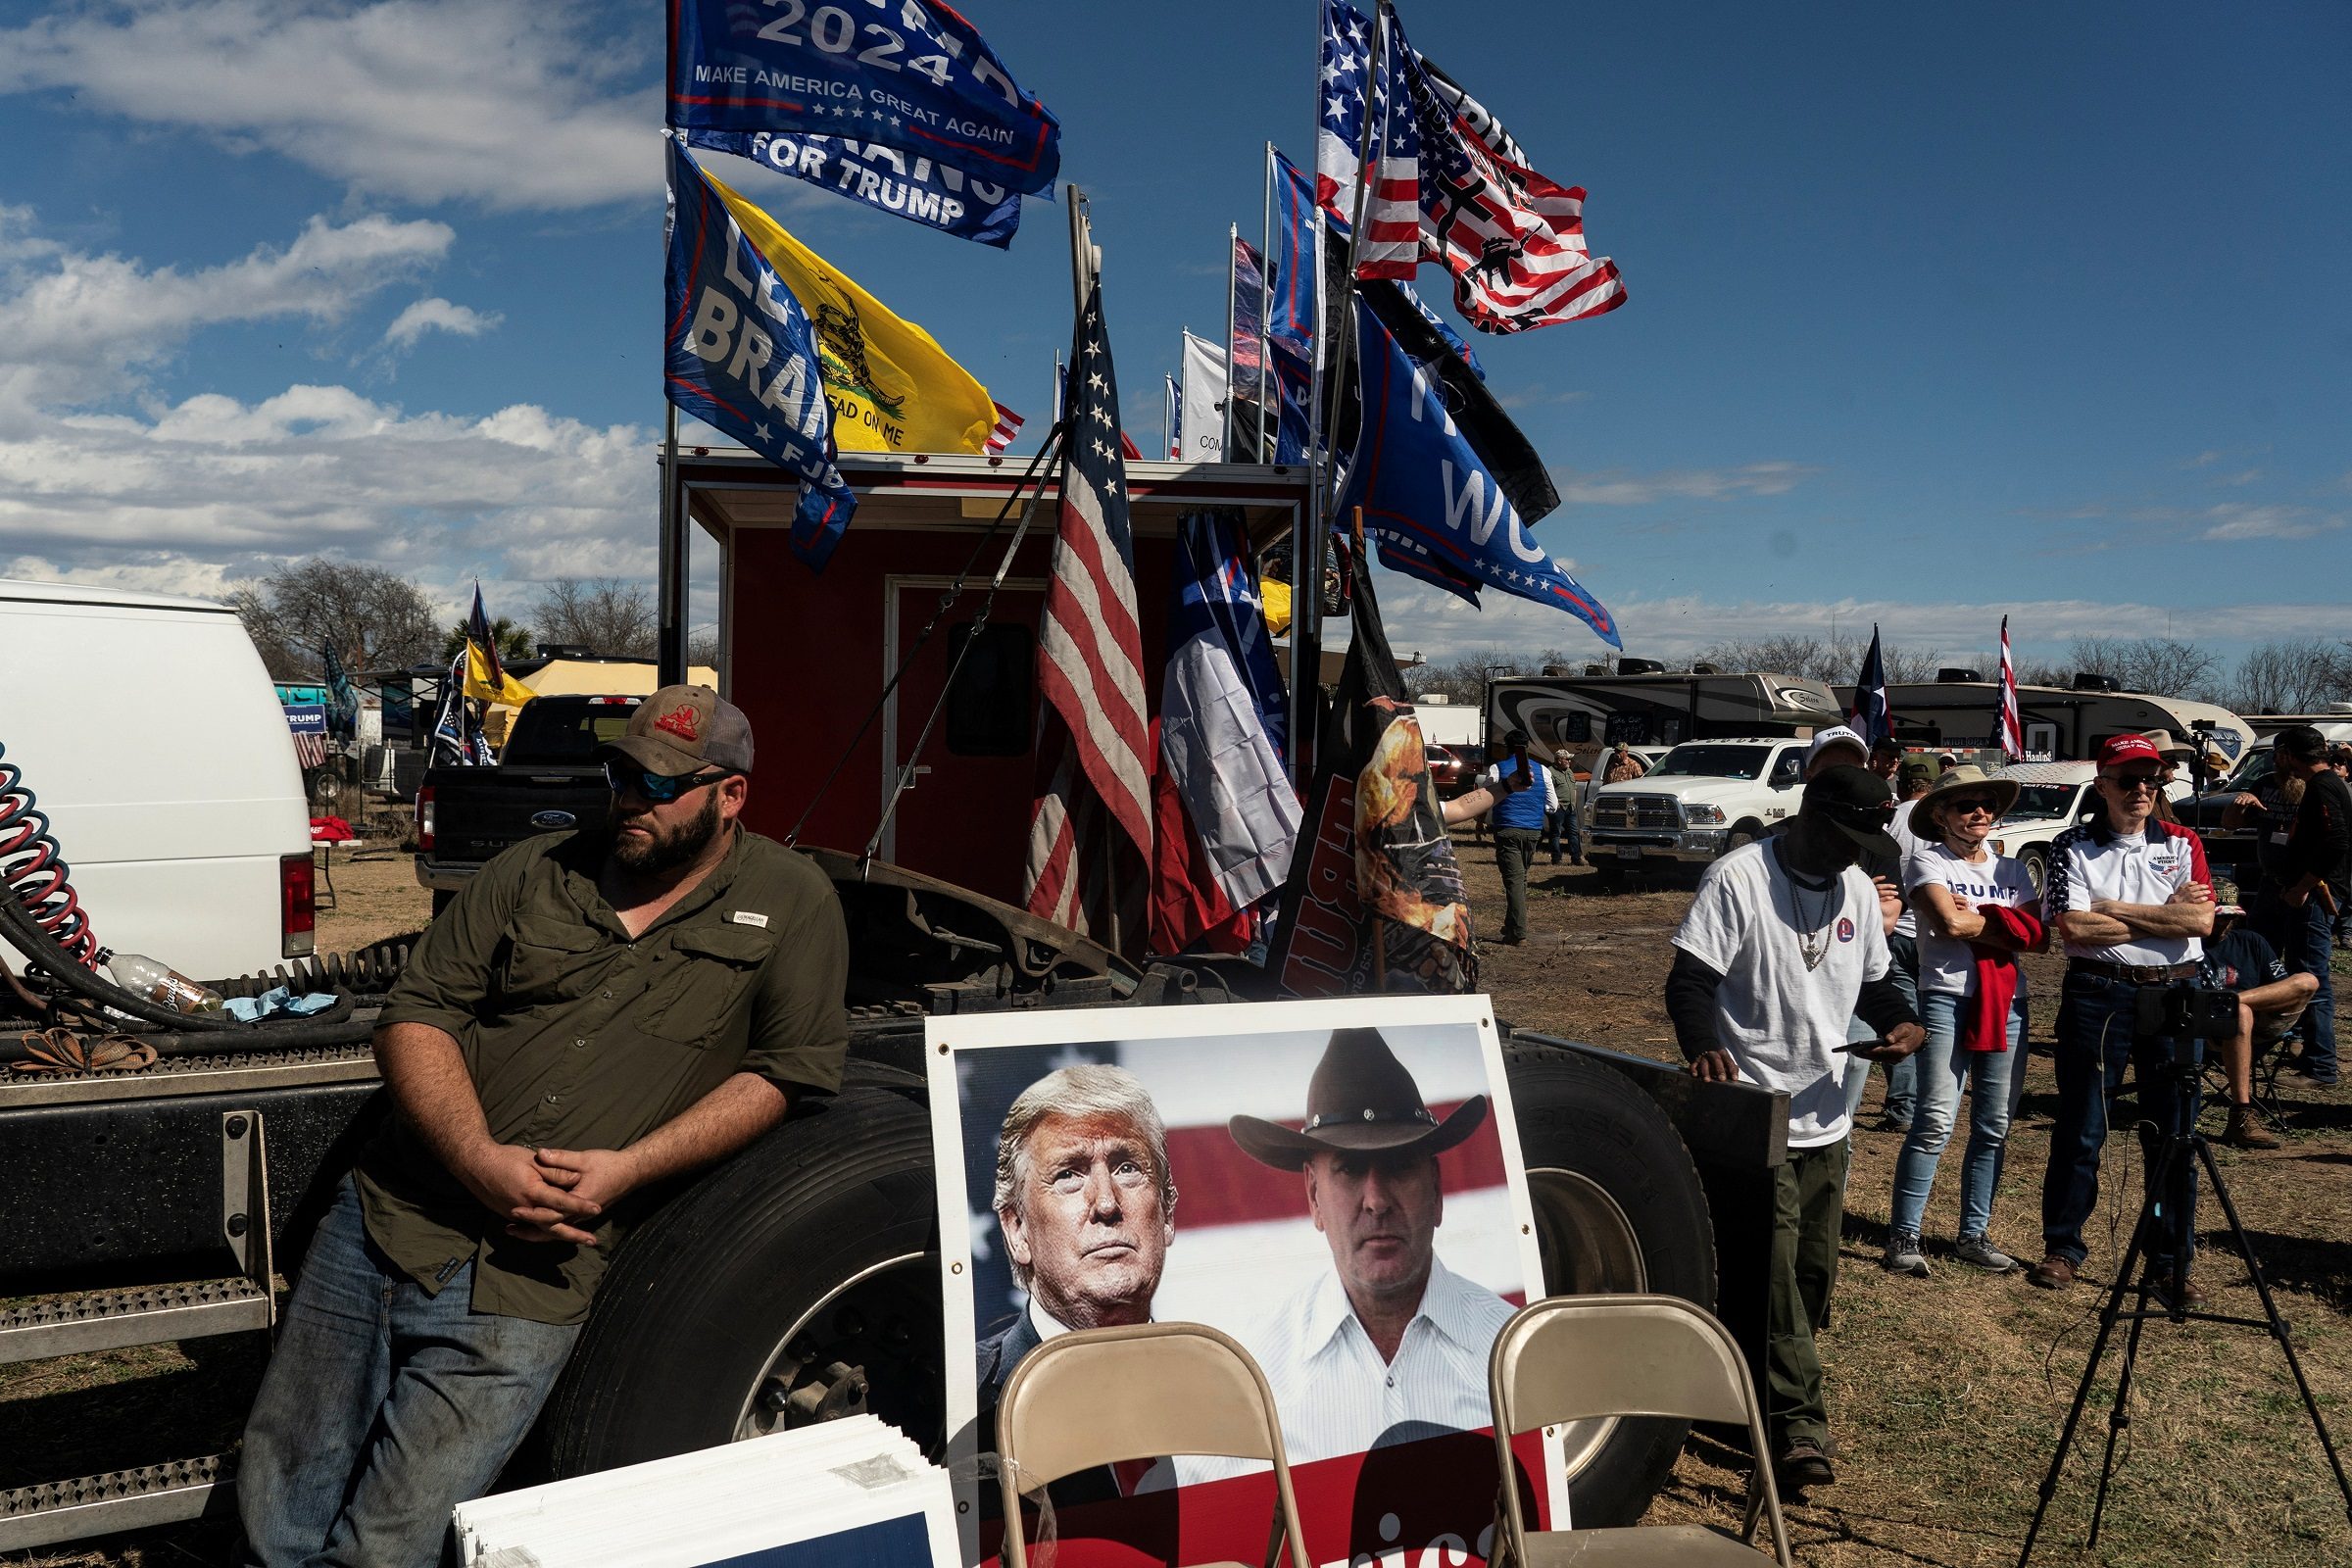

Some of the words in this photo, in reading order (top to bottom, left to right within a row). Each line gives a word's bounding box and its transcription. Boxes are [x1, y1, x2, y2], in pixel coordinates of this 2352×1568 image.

[757, 0, 954, 86] 2024
[696, 65, 747, 84] MAKE
[754, 70, 862, 100] AMERICA
[870, 89, 940, 126] GREAT
[946, 117, 1013, 145] AGAIN
[753, 132, 827, 178] FOR
[840, 157, 964, 225] TRUMP
[783, 441, 844, 489] FJB
[863, 411, 880, 432] ON
[883, 422, 905, 446] ME
